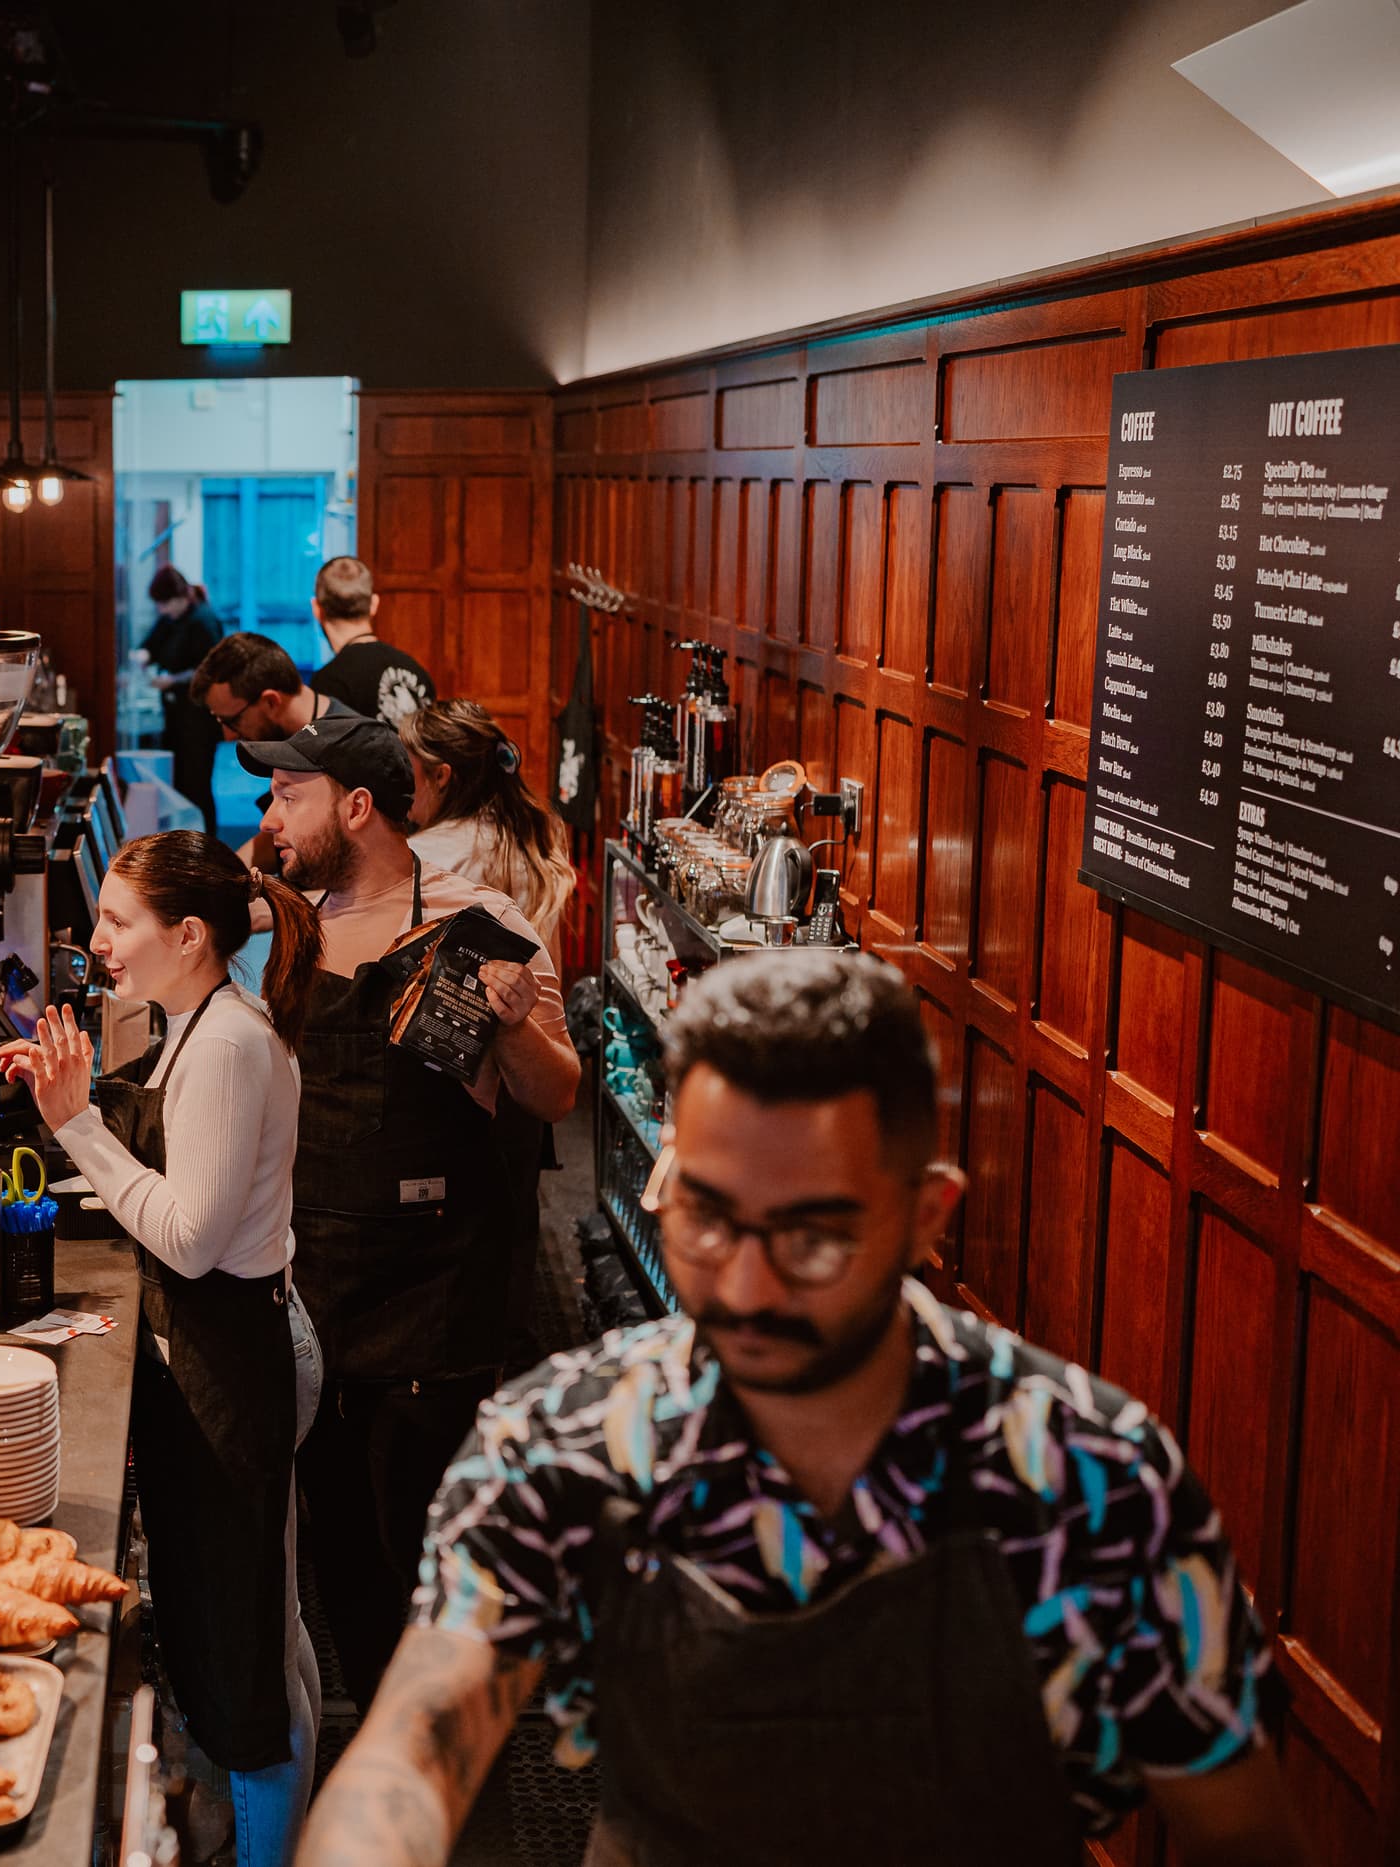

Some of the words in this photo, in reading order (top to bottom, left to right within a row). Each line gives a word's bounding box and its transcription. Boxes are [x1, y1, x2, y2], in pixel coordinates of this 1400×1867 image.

[1121, 411, 1156, 442] COFFEE
[1268, 402, 1295, 437] NOT
[1295, 398, 1344, 437] COFFEE
[1118, 463, 1143, 480] Espresso
[1222, 465, 1243, 480] £2.75
[1264, 460, 1301, 482] Speciality
[1300, 461, 1315, 479] Tea
[1116, 490, 1145, 505] Macchiato
[1220, 493, 1240, 511] £2.85
[1115, 517, 1137, 532] Cortado
[1218, 525, 1238, 541] £3.15
[1113, 544, 1127, 561] Long
[1127, 545, 1143, 560] Black
[1259, 535, 1273, 552] Hot
[1273, 535, 1310, 555] Chocolate
[1216, 554, 1236, 570] £3.30
[1111, 571, 1141, 587] Americano
[1256, 568, 1302, 591] Matcha/Chai
[1302, 572, 1323, 591] Latte
[1214, 584, 1234, 601] £3.45
[1110, 597, 1121, 612] Flat
[1121, 598, 1138, 614] White
[1254, 601, 1288, 621] Turmeric
[1288, 605, 1308, 624] Latte
[1212, 613, 1232, 630] £3.50
[1108, 623, 1122, 639] Latte
[1209, 642, 1230, 659] £3.80
[1251, 634, 1293, 657] Milkshakes
[1106, 650, 1128, 667] Spanish
[1127, 654, 1142, 670] Latte
[1104, 676, 1136, 696] Cappuccino
[1207, 672, 1228, 689] £4.60
[1102, 702, 1121, 720] Mocha
[1205, 701, 1225, 718] £3.80
[1246, 702, 1284, 727] Smoothies
[1101, 730, 1117, 748] Batch
[1116, 735, 1131, 751] Brew
[1203, 730, 1223, 748] £4.20
[1098, 756, 1113, 774] Brew
[1113, 761, 1124, 777] Bar
[1201, 759, 1221, 778] £3.40
[1199, 788, 1219, 806] £4.20
[1239, 801, 1266, 828] EXTRAS
